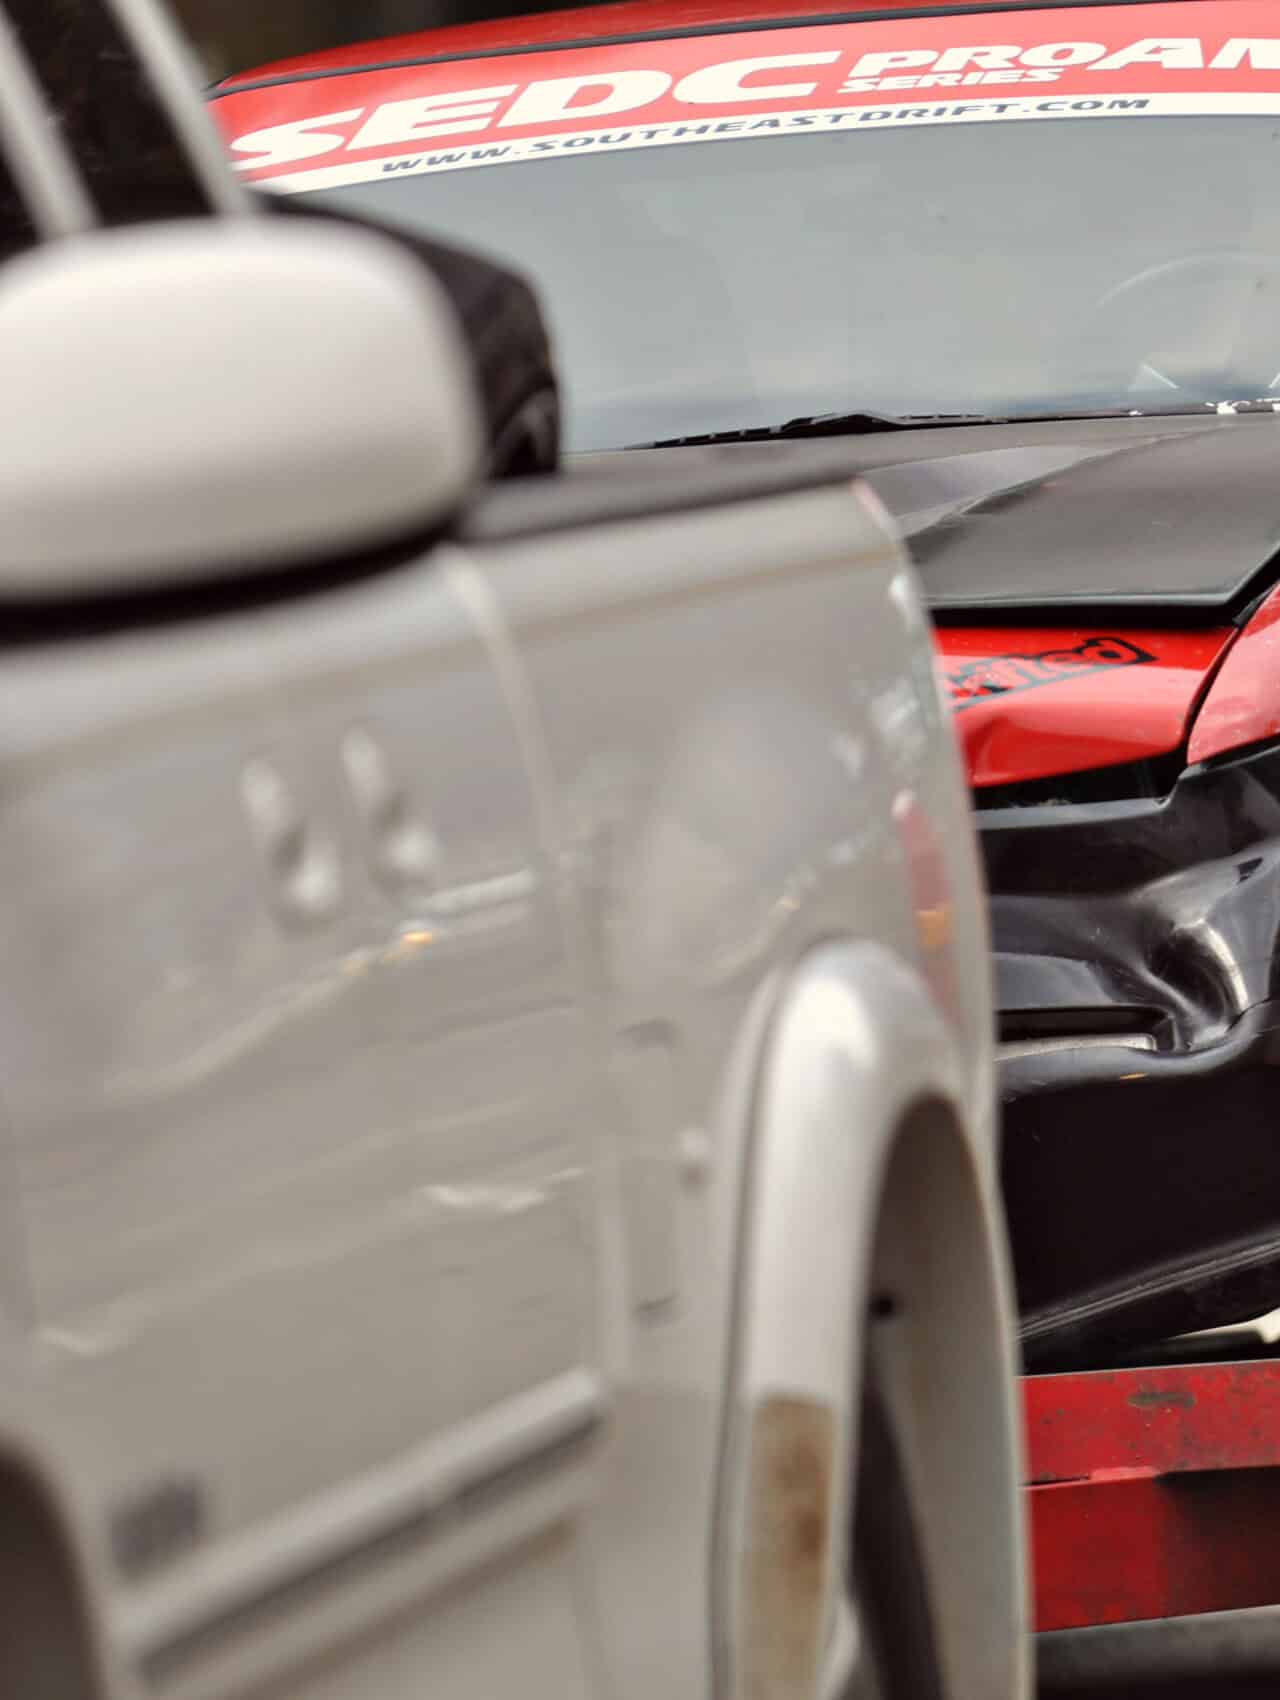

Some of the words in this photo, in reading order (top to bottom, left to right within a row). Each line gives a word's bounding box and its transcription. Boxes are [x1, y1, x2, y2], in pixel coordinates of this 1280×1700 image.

[229, 50, 841, 169] SEDC
[838, 67, 1064, 94] SERIES
[381, 98, 1150, 173] WWW.SOUTHEASTDRIFT.COM
